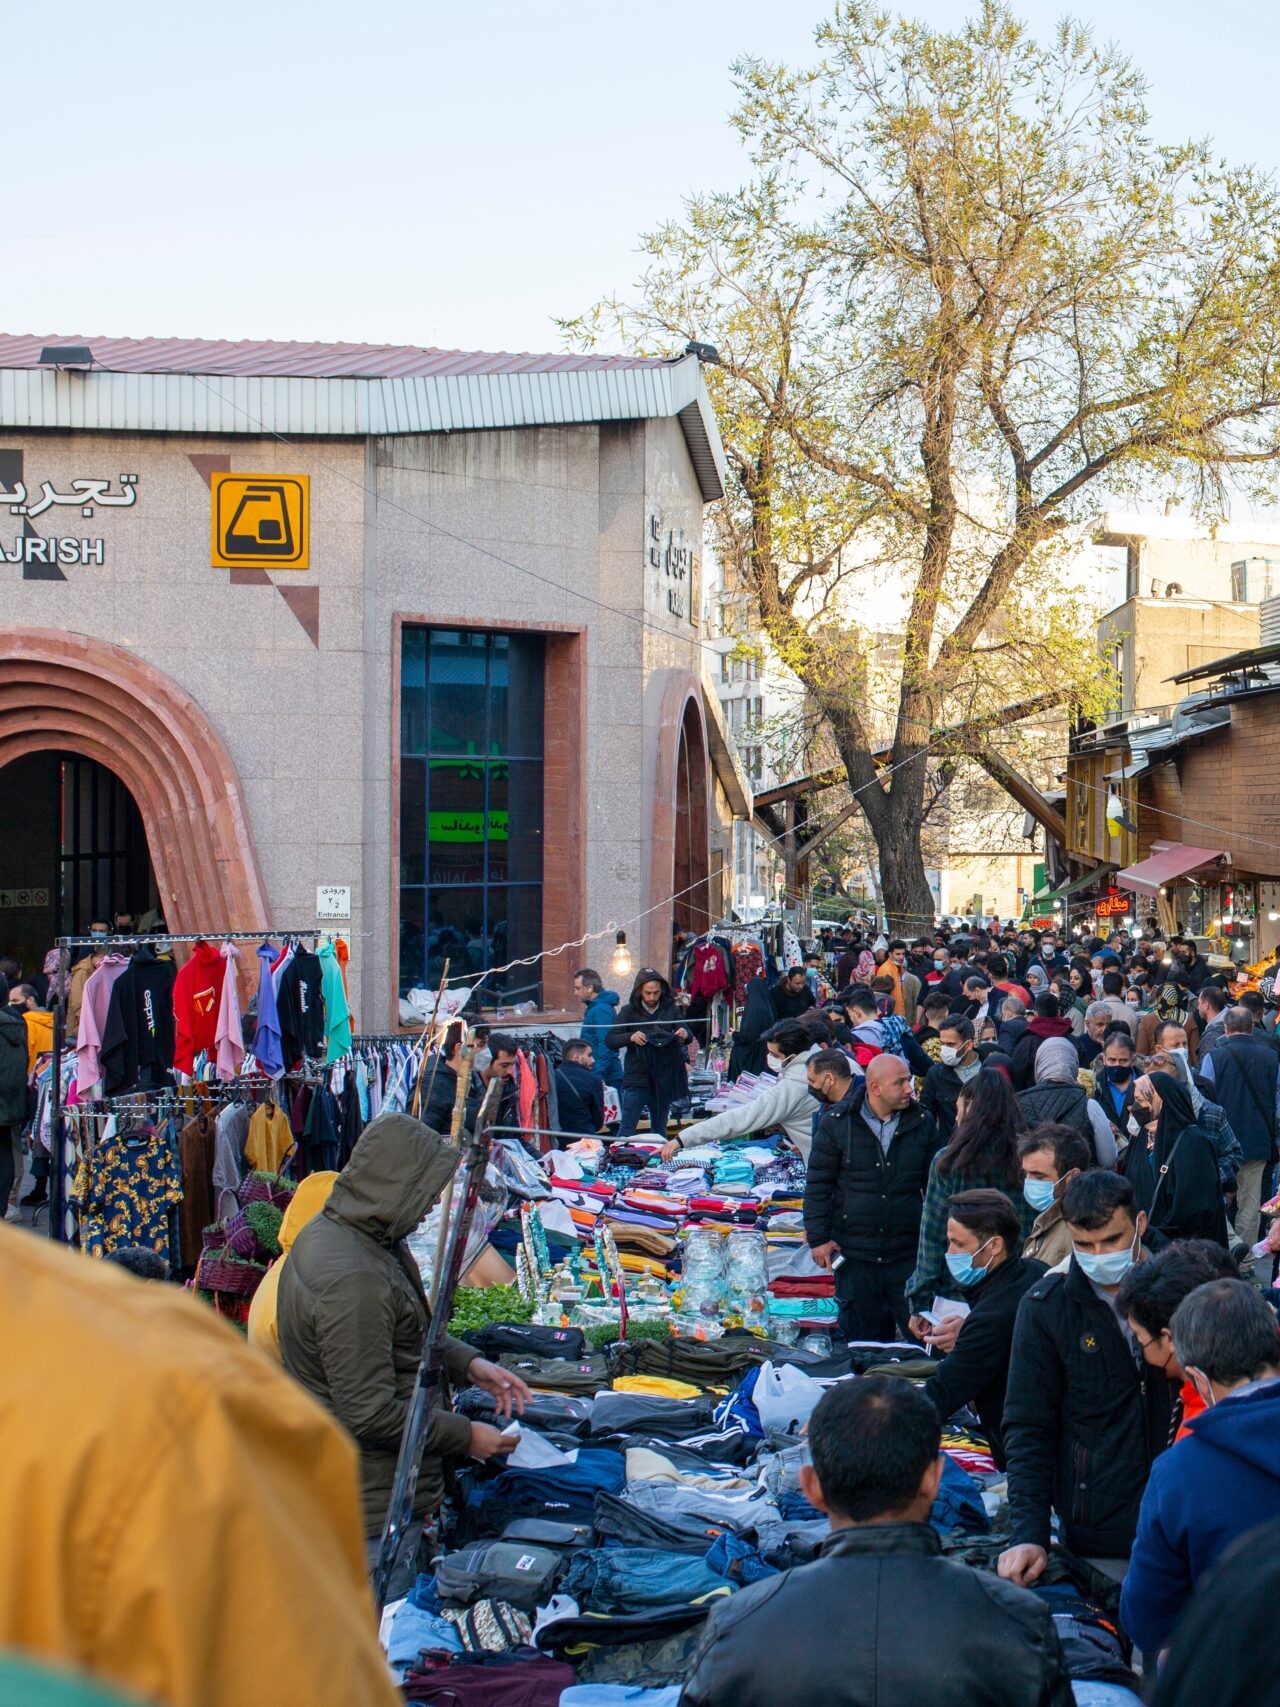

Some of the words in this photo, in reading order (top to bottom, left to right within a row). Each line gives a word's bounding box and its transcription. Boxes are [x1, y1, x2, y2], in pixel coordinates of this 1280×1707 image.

[0, 474, 139, 519] تجری
[322, 887, 346, 895] ورودی
[1096, 897, 1128, 916] عطاری
[143, 989, 154, 1030] esprit
